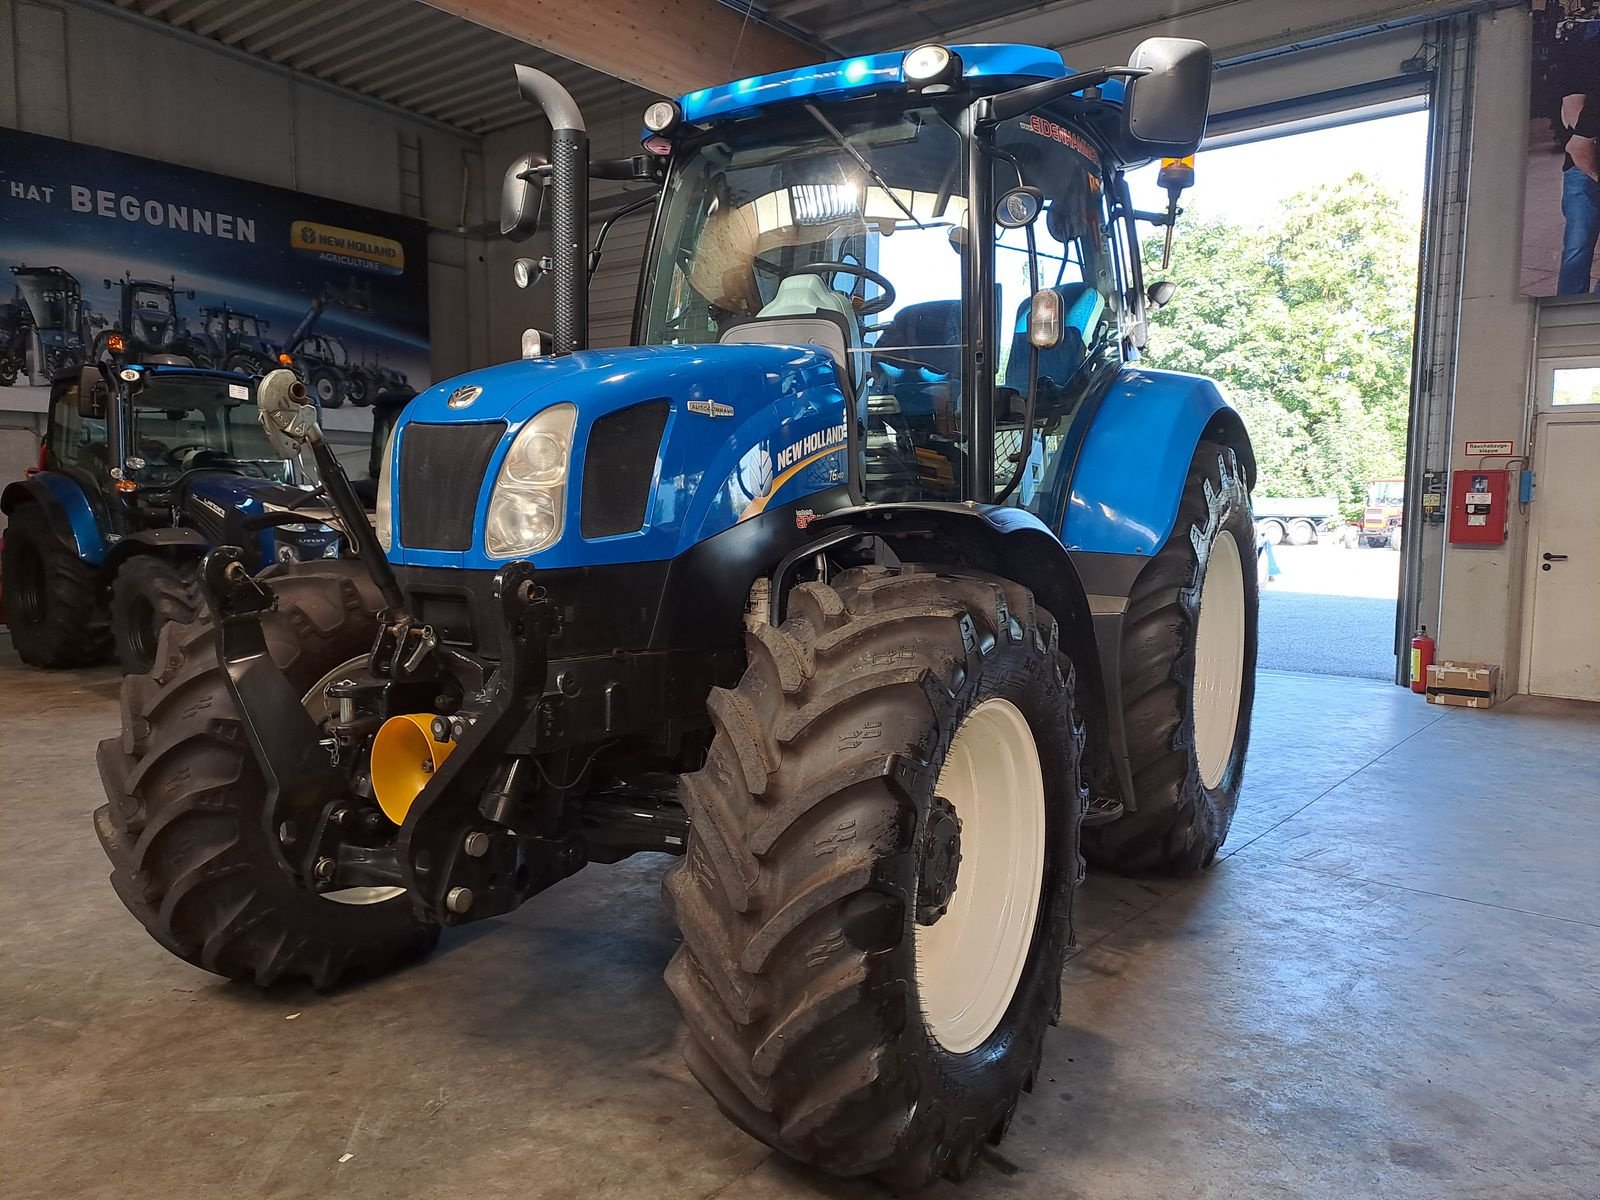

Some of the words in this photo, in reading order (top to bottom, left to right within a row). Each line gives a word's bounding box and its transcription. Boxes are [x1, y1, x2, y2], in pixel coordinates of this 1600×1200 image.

[10, 181, 54, 204] HAT
[70, 185, 256, 243] BEGONNEN
[319, 234, 345, 248] NEW
[347, 240, 396, 258] HOLLAND
[320, 252, 380, 270] AGRICULTURE
[777, 440, 803, 472] NEW
[803, 424, 844, 455] HOLLAND
